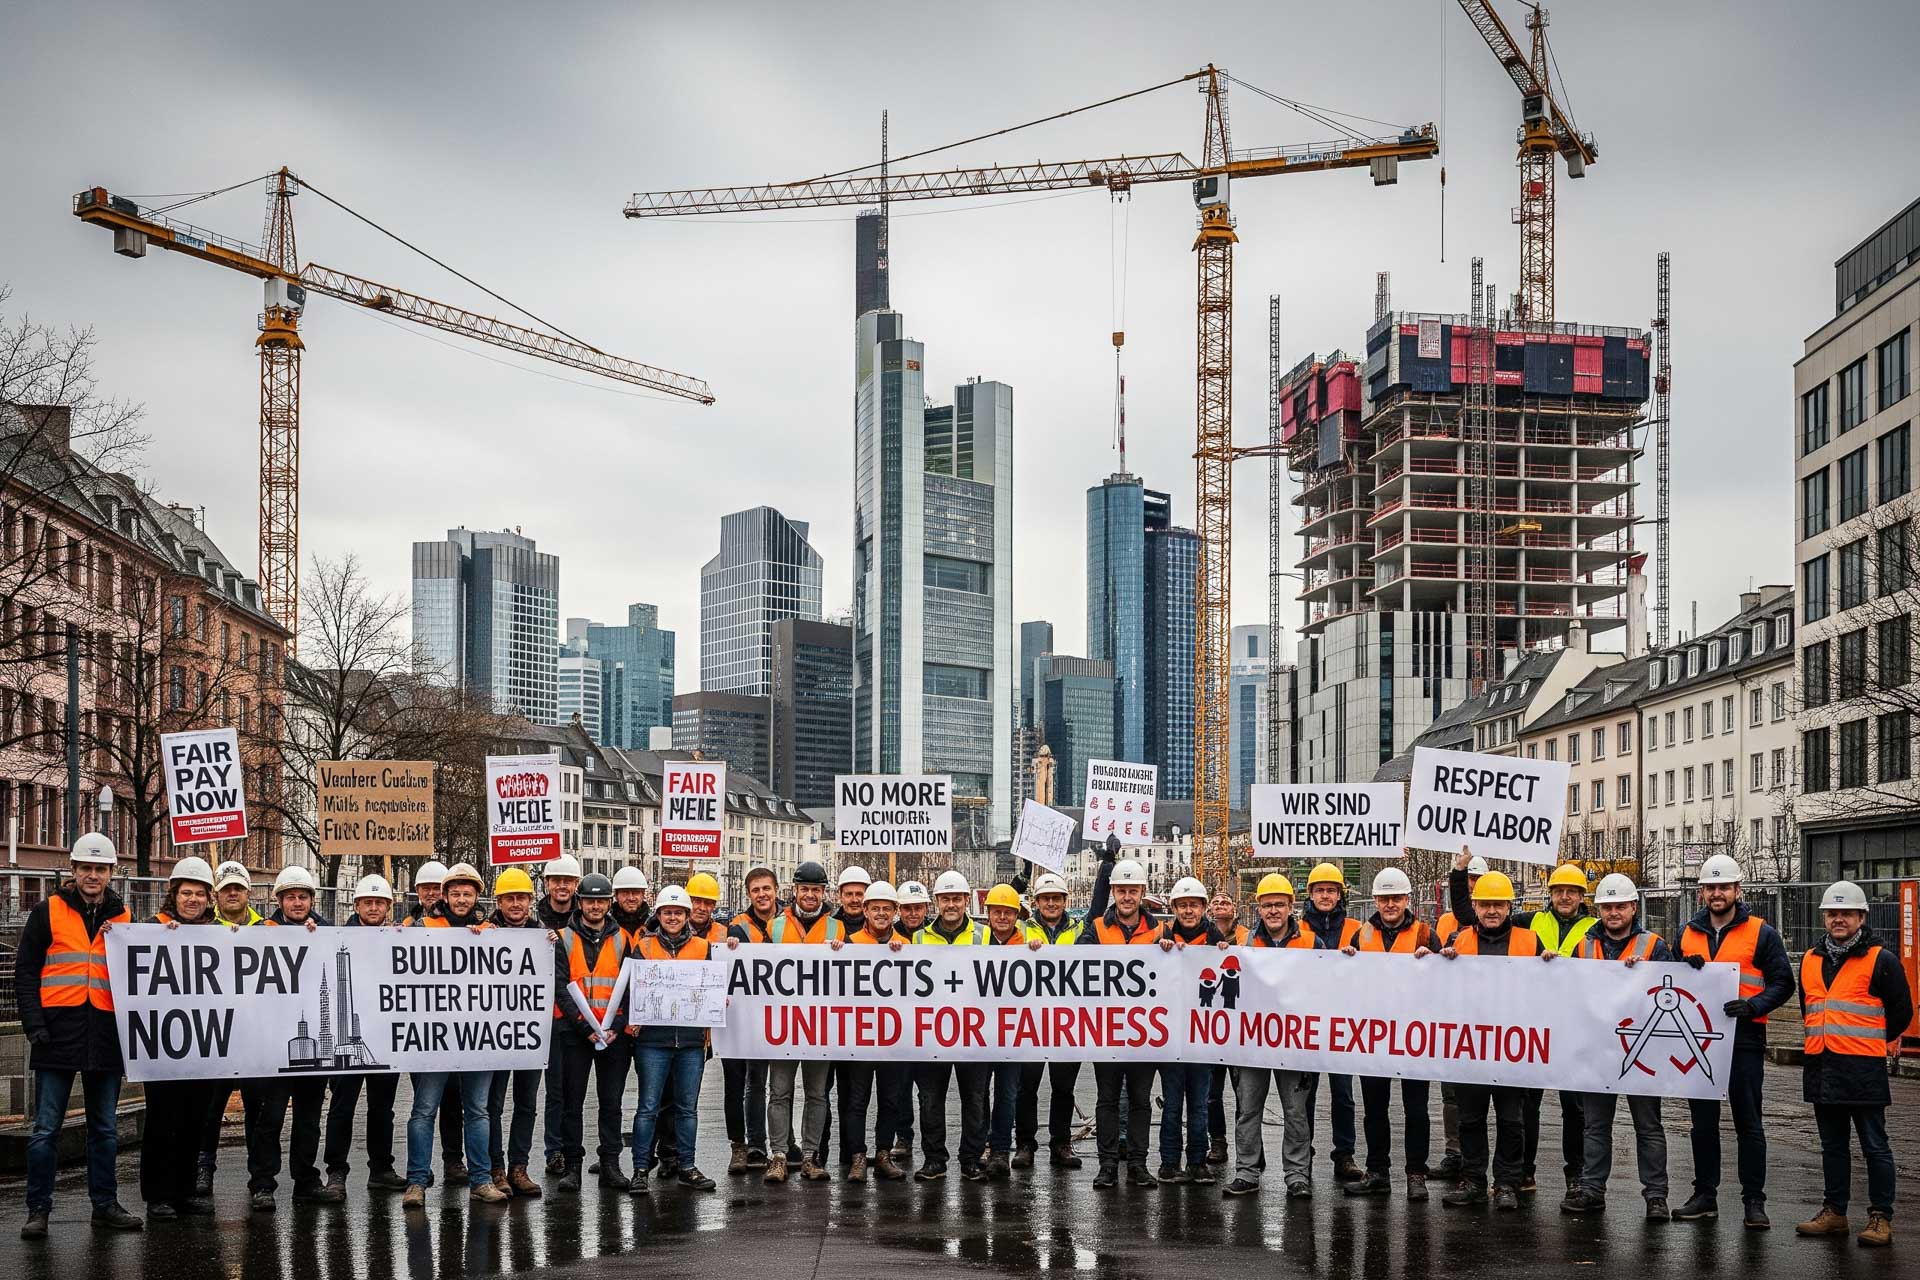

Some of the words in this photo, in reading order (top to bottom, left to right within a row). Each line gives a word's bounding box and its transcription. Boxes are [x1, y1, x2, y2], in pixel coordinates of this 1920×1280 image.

[171, 742, 232, 766] FAIR
[175, 764, 232, 791] PAY
[669, 772, 716, 795] FAIR
[1433, 765, 1540, 803] RESPECT
[175, 789, 238, 815] NOW
[842, 782, 874, 806] NO
[881, 782, 946, 806] MORE
[1282, 792, 1320, 815] WIR
[1325, 792, 1370, 816] SIND
[841, 829, 947, 846] EXPLOITATION
[1258, 822, 1401, 847] UNTERBEZAHLT
[1418, 804, 1468, 836] OUR
[1473, 810, 1552, 846] LABOR
[127, 945, 223, 996] FAIR
[234, 945, 309, 995] PAY
[391, 945, 513, 976] BUILDING
[518, 946, 537, 976] A
[727, 958, 935, 998] ARCHITECTS
[943, 970, 964, 994] +
[973, 958, 1157, 998] WORKERS:
[380, 984, 462, 1013] BETTER
[467, 983, 546, 1012] FUTURE
[128, 1008, 235, 1061] NOW
[391, 1021, 449, 1053] FAIR
[453, 1020, 542, 1052] WAGES
[764, 1005, 903, 1048] UNITED
[915, 1006, 988, 1048] FOR
[997, 1006, 1169, 1048] FAIRNESS
[1190, 1008, 1231, 1046] NO
[1239, 1011, 1321, 1051] MORE
[1328, 1016, 1551, 1064] EXPLOITATION
